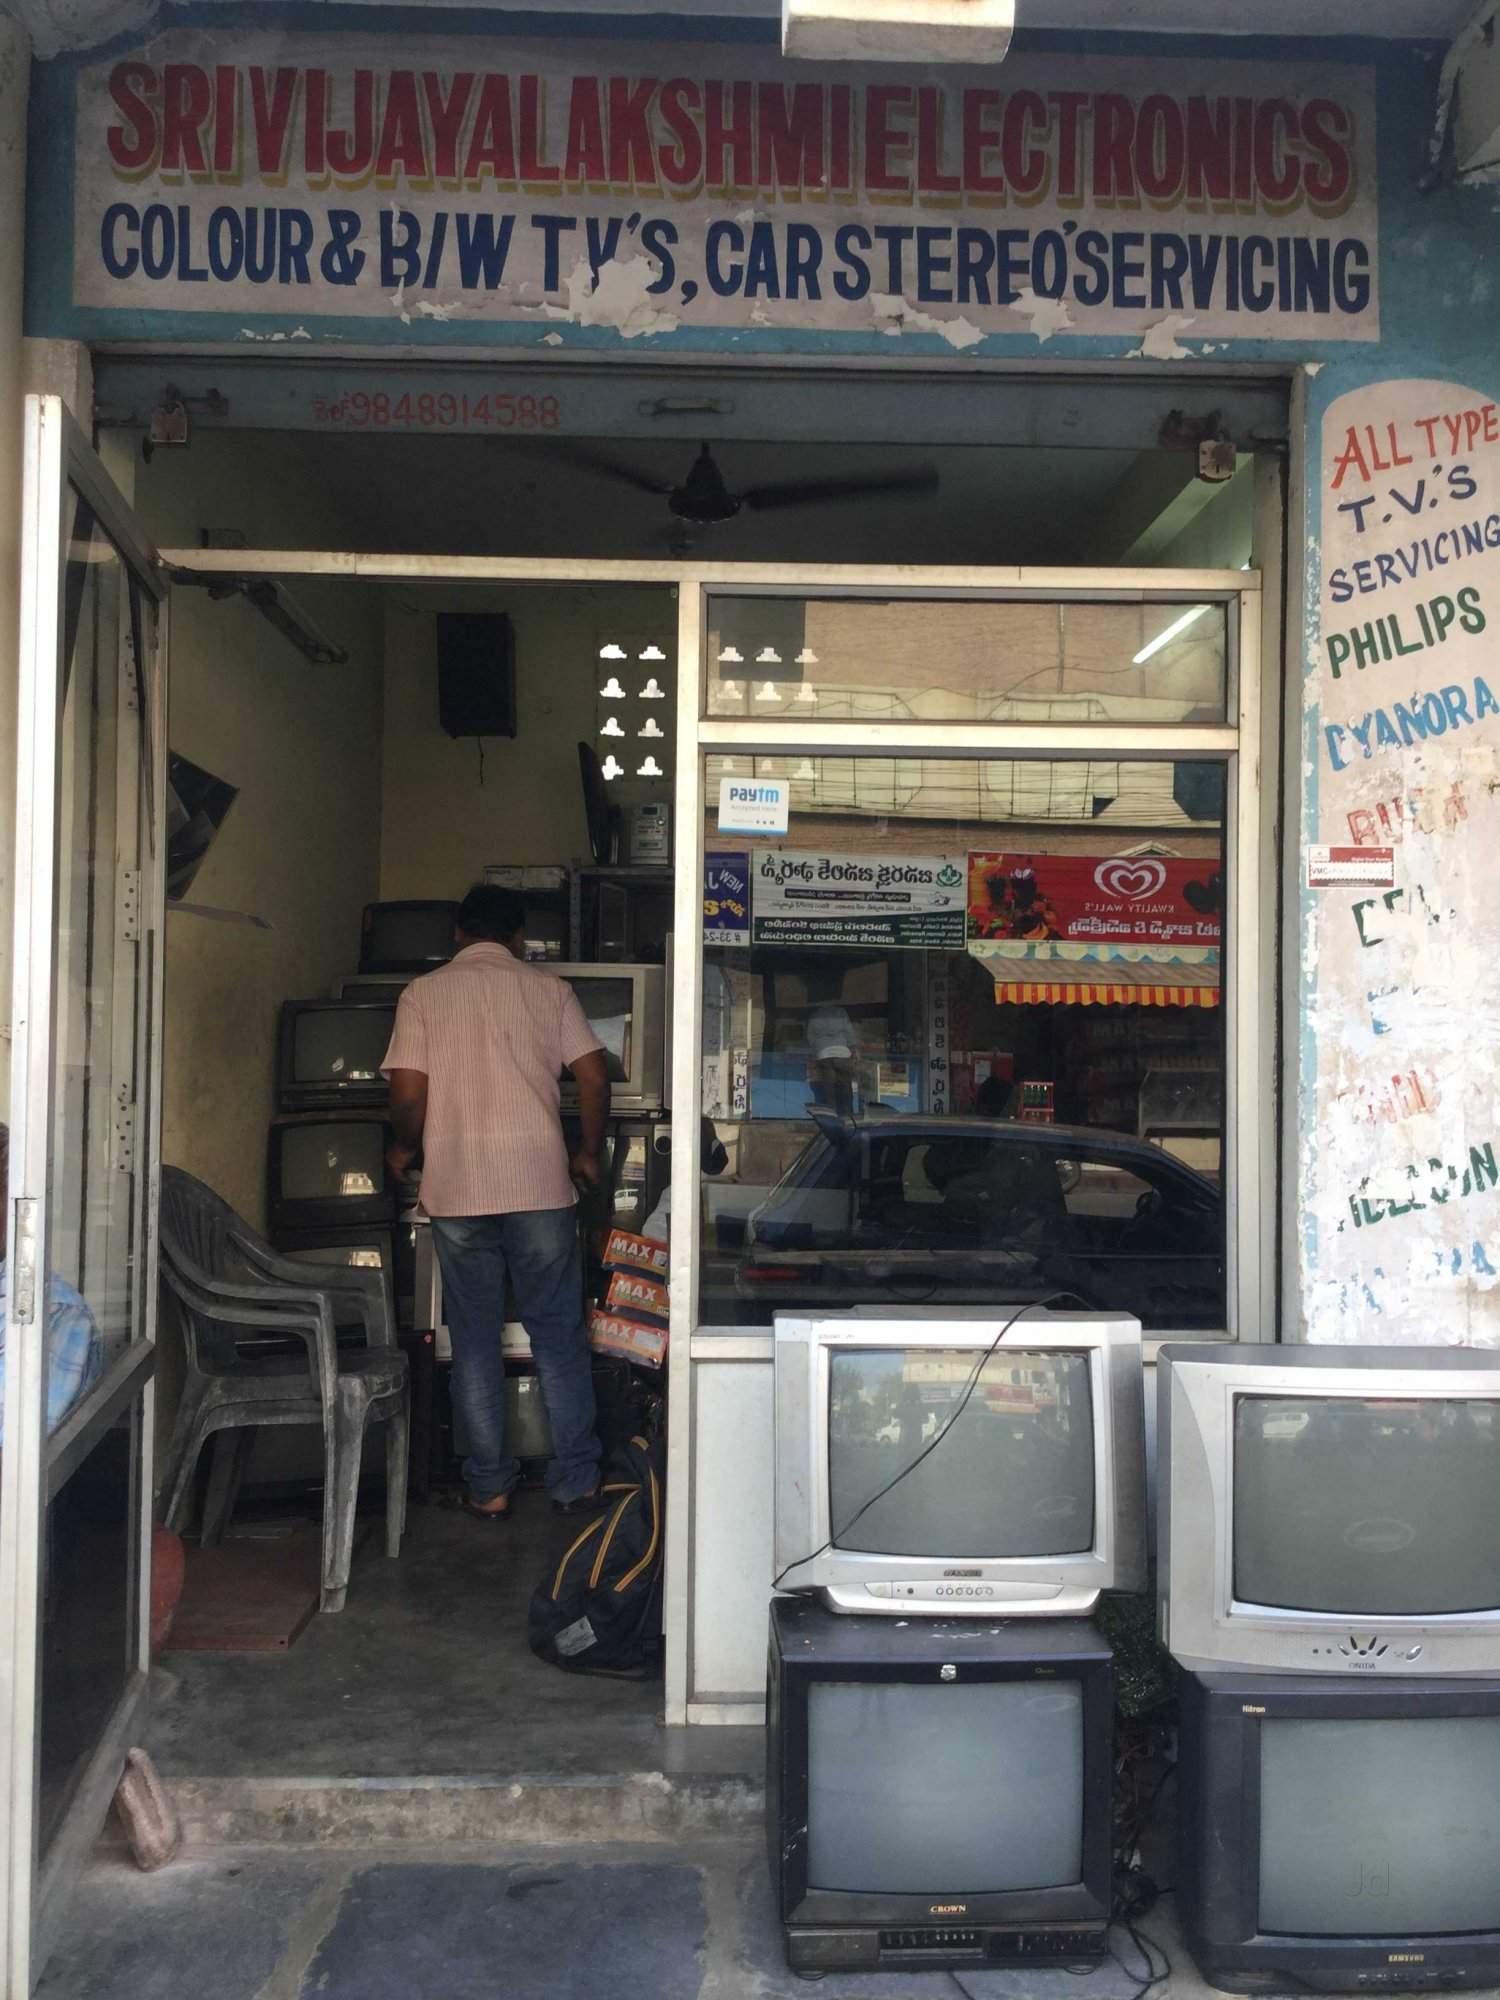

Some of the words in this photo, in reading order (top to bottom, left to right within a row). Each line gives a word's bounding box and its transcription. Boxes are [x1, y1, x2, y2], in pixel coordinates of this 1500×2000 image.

[864, 84, 1352, 212] ELECTRONICS
[101, 203, 314, 285] COLOUR
[320, 209, 366, 286] &
[380, 208, 516, 291] B/W
[706, 219, 822, 302] CAR
[1331, 421, 1413, 489] ALL
[1414, 404, 1499, 458] TYPE
[1329, 514, 1500, 603] SERVICING
[1326, 586, 1486, 679] PHILIPS
[730, 787, 779, 802] paytm
[611, 1237, 651, 1258] MAX
[615, 1279, 657, 1301] MAX
[592, 1317, 633, 1339] MAX
[929, 1904, 967, 1914] CROWN
